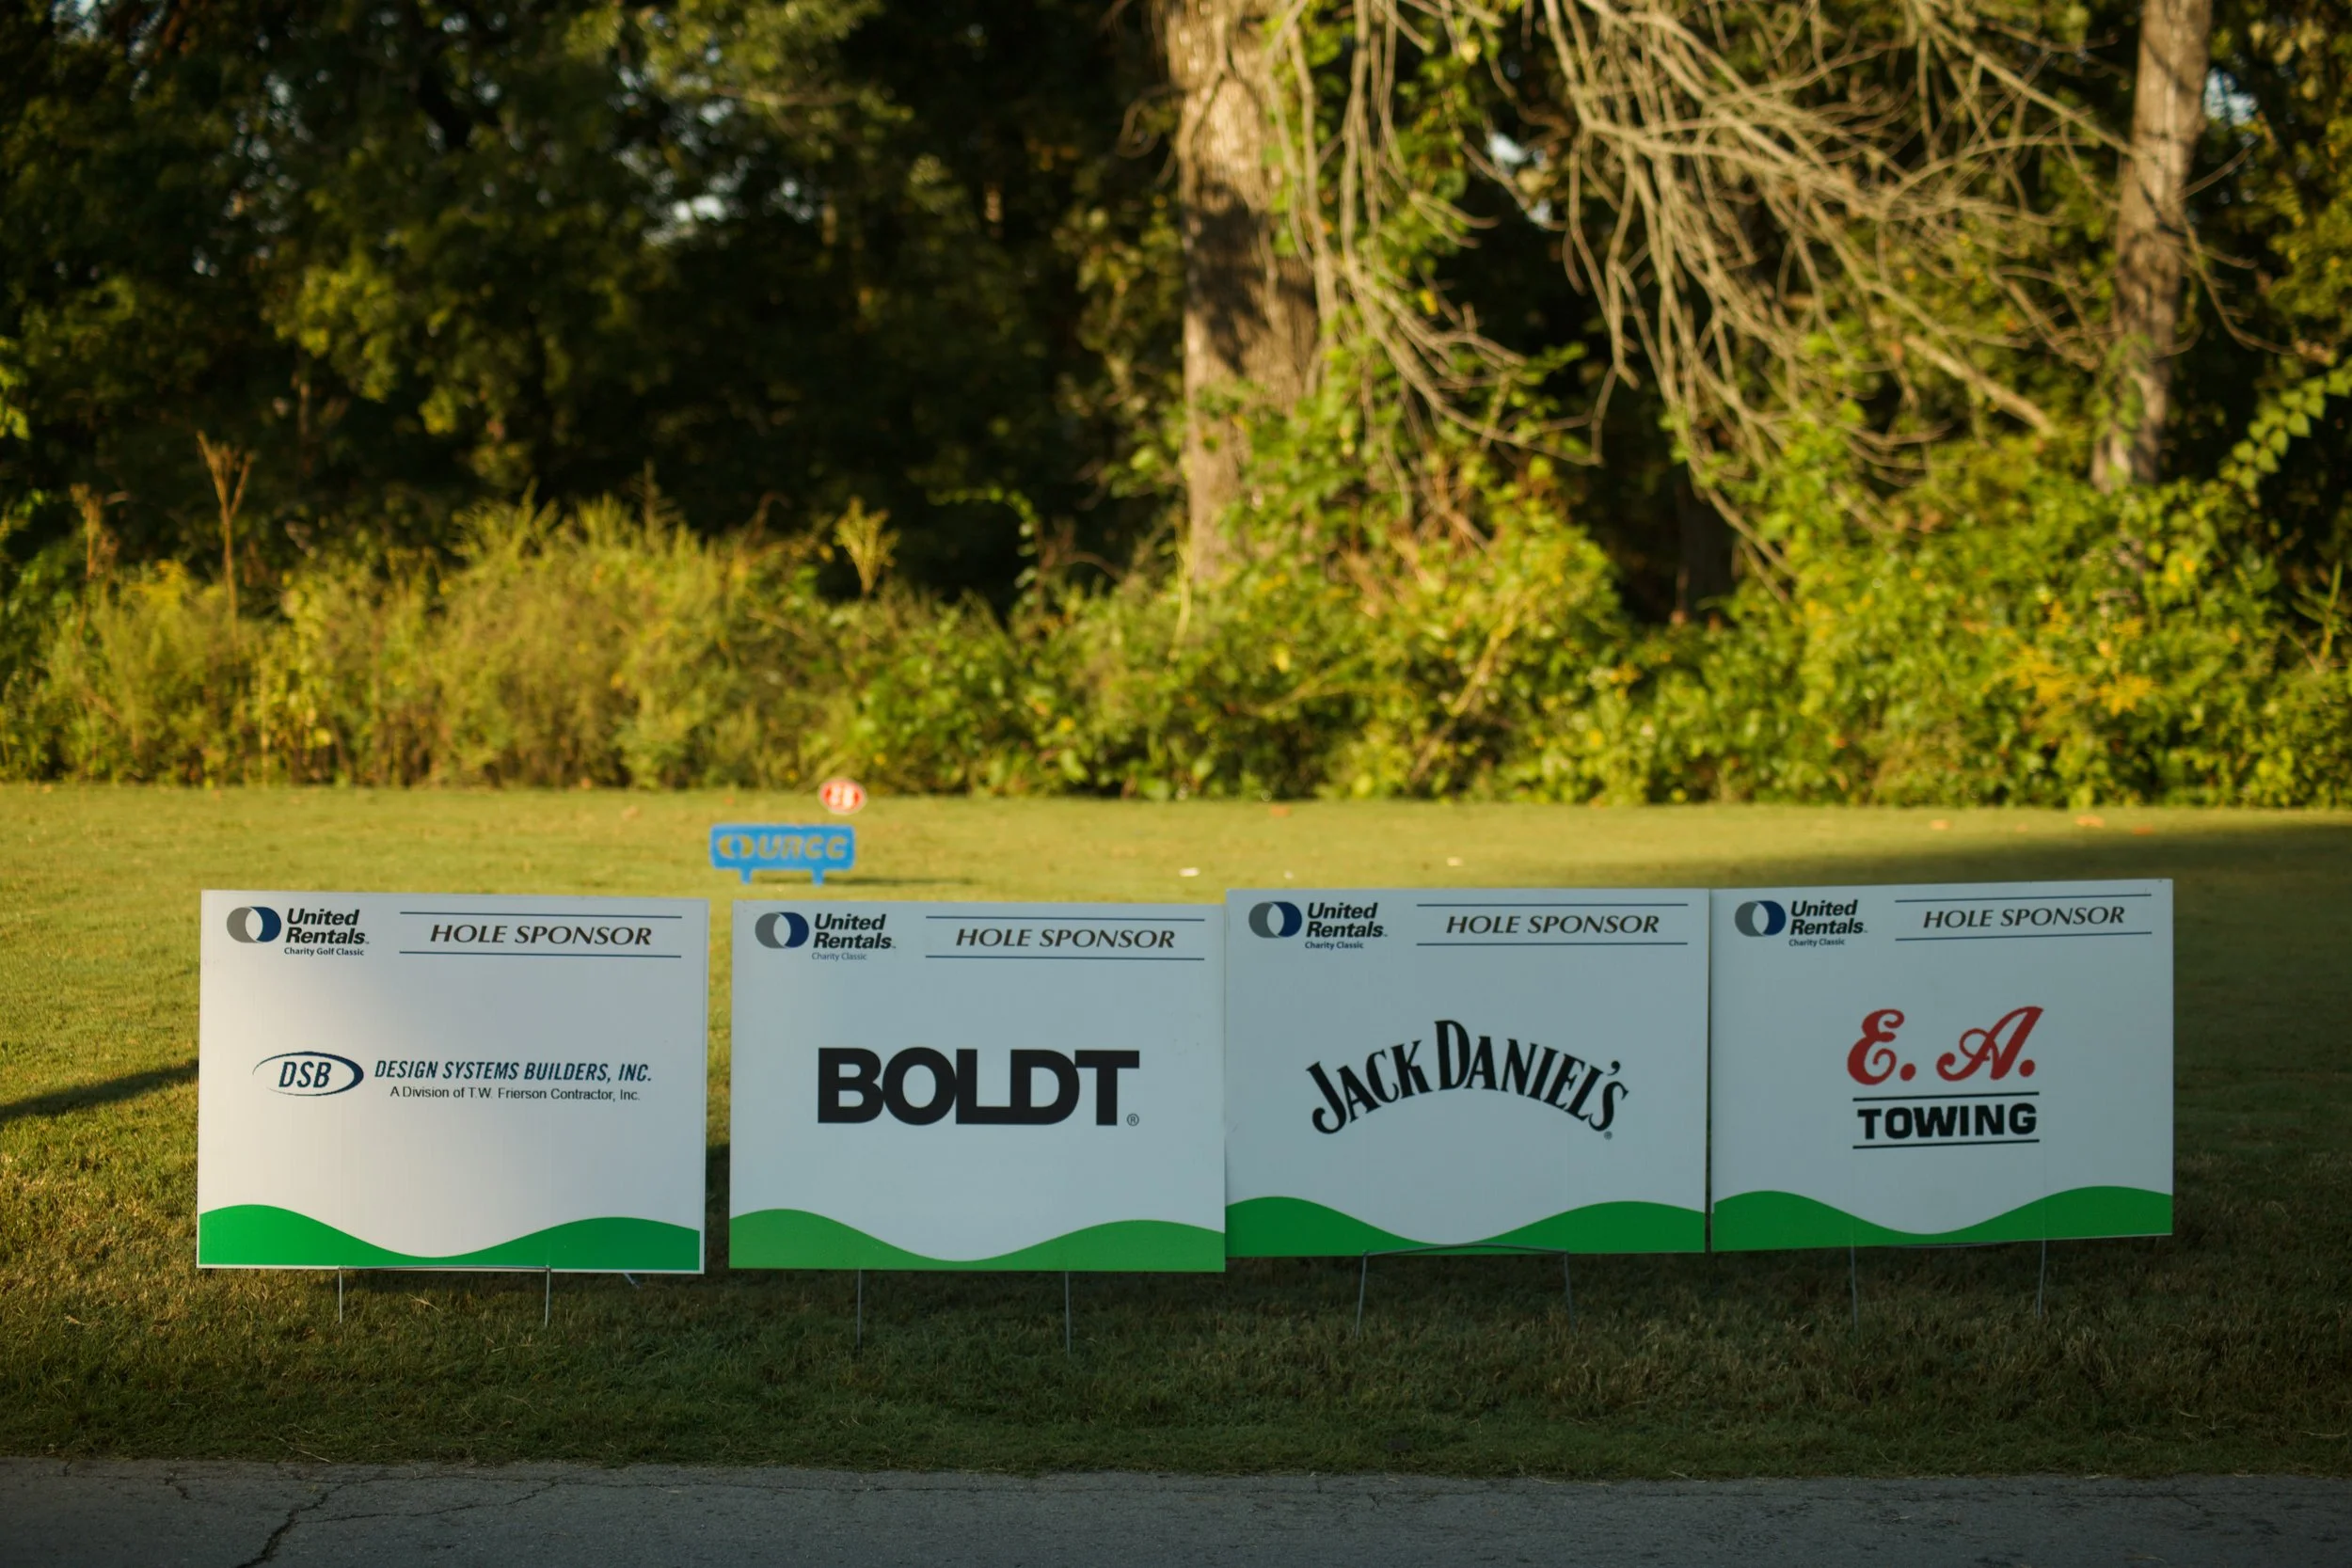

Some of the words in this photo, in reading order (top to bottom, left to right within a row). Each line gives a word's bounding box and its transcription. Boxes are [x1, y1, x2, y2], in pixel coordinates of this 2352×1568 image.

[286, 908, 360, 926] United
[1307, 902, 1378, 919] United
[1790, 899, 1858, 917] United
[1923, 909, 1994, 928] HOLE
[2000, 906, 2125, 927] SPONSOR
[814, 913, 886, 930] United
[1306, 921, 1384, 938] Rentals
[1446, 915, 1520, 934] HOLE
[1527, 914, 1660, 934] SPONSOR
[1789, 918, 1864, 935] Rentals
[285, 927, 366, 944] Rentals
[430, 924, 507, 943] HOLE
[515, 925, 653, 945] SPONSOR
[813, 932, 892, 949] Rentals
[955, 927, 1031, 947] HOLE
[1040, 928, 1175, 949] SPONSOR
[1788, 939, 1818, 947] Charity
[1819, 938, 1845, 946] Classic
[284, 946, 315, 957] Charity
[316, 947, 335, 956] Golf
[336, 947, 365, 956] Classic
[1305, 941, 1335, 950] Charity
[1336, 941, 1364, 949] Classic
[811, 952, 840, 961] Charity
[841, 952, 867, 960] Classic
[1847, 1008, 1916, 1085] E.
[1936, 1006, 2043, 1082] A.
[278, 1060, 332, 1089] DSB
[374, 1060, 438, 1079] DESIGN
[442, 1061, 519, 1081] SYSTEMS
[524, 1062, 612, 1084] BUILDERS,
[618, 1064, 653, 1082] INC.
[1306, 1039, 1433, 1135] JACK
[1434, 1020, 1629, 1132] DANIEL'S
[389, 1086, 400, 1098] A
[403, 1085, 450, 1099] Division
[453, 1086, 465, 1099] of
[469, 1086, 493, 1100] T.W.
[498, 1087, 548, 1101] Frierson
[550, 1088, 616, 1102] Contractor,
[620, 1089, 641, 1101] Inc.
[818, 1047, 1140, 1126] BOLDT
[1857, 1102, 2037, 1140] TOWING
